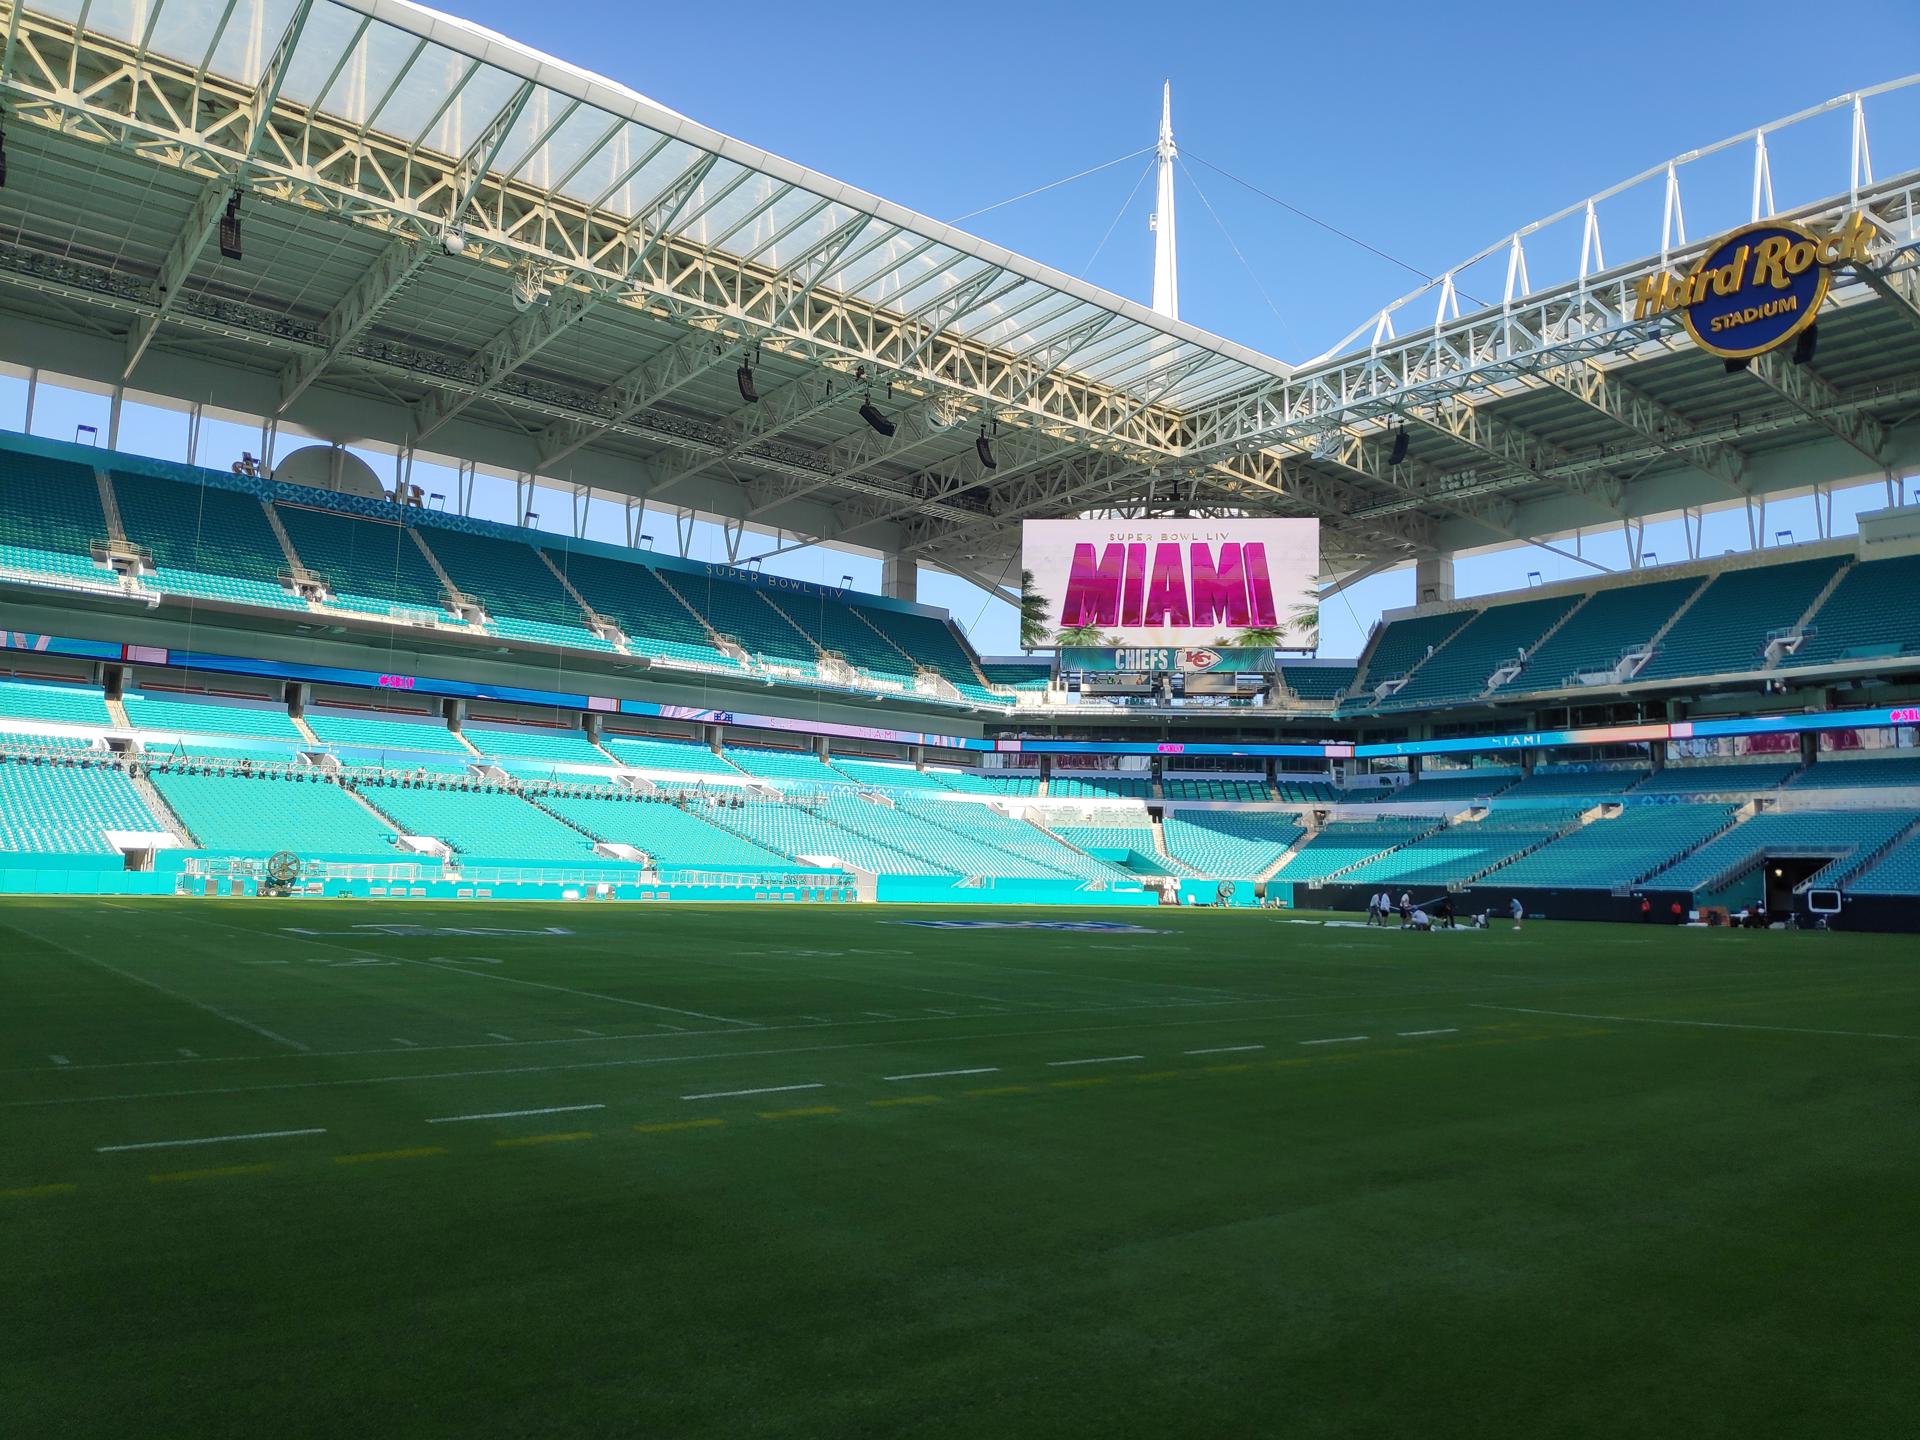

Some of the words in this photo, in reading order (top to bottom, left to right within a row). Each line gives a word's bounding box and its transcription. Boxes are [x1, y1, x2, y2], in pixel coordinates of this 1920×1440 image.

[1633, 245, 1749, 320] Hard
[1752, 211, 1877, 289] Rock
[1711, 295, 1798, 332] STADIUM
[1109, 533, 1153, 541] SUPER
[1160, 533, 1198, 541] BOWL
[1206, 532, 1230, 541] LIV
[706, 564, 759, 583] SUPER
[768, 576, 811, 593] BOWL
[819, 586, 844, 599] LIV
[1060, 542, 1278, 627] MIAMI
[1115, 648, 1168, 670] CHIEFS
